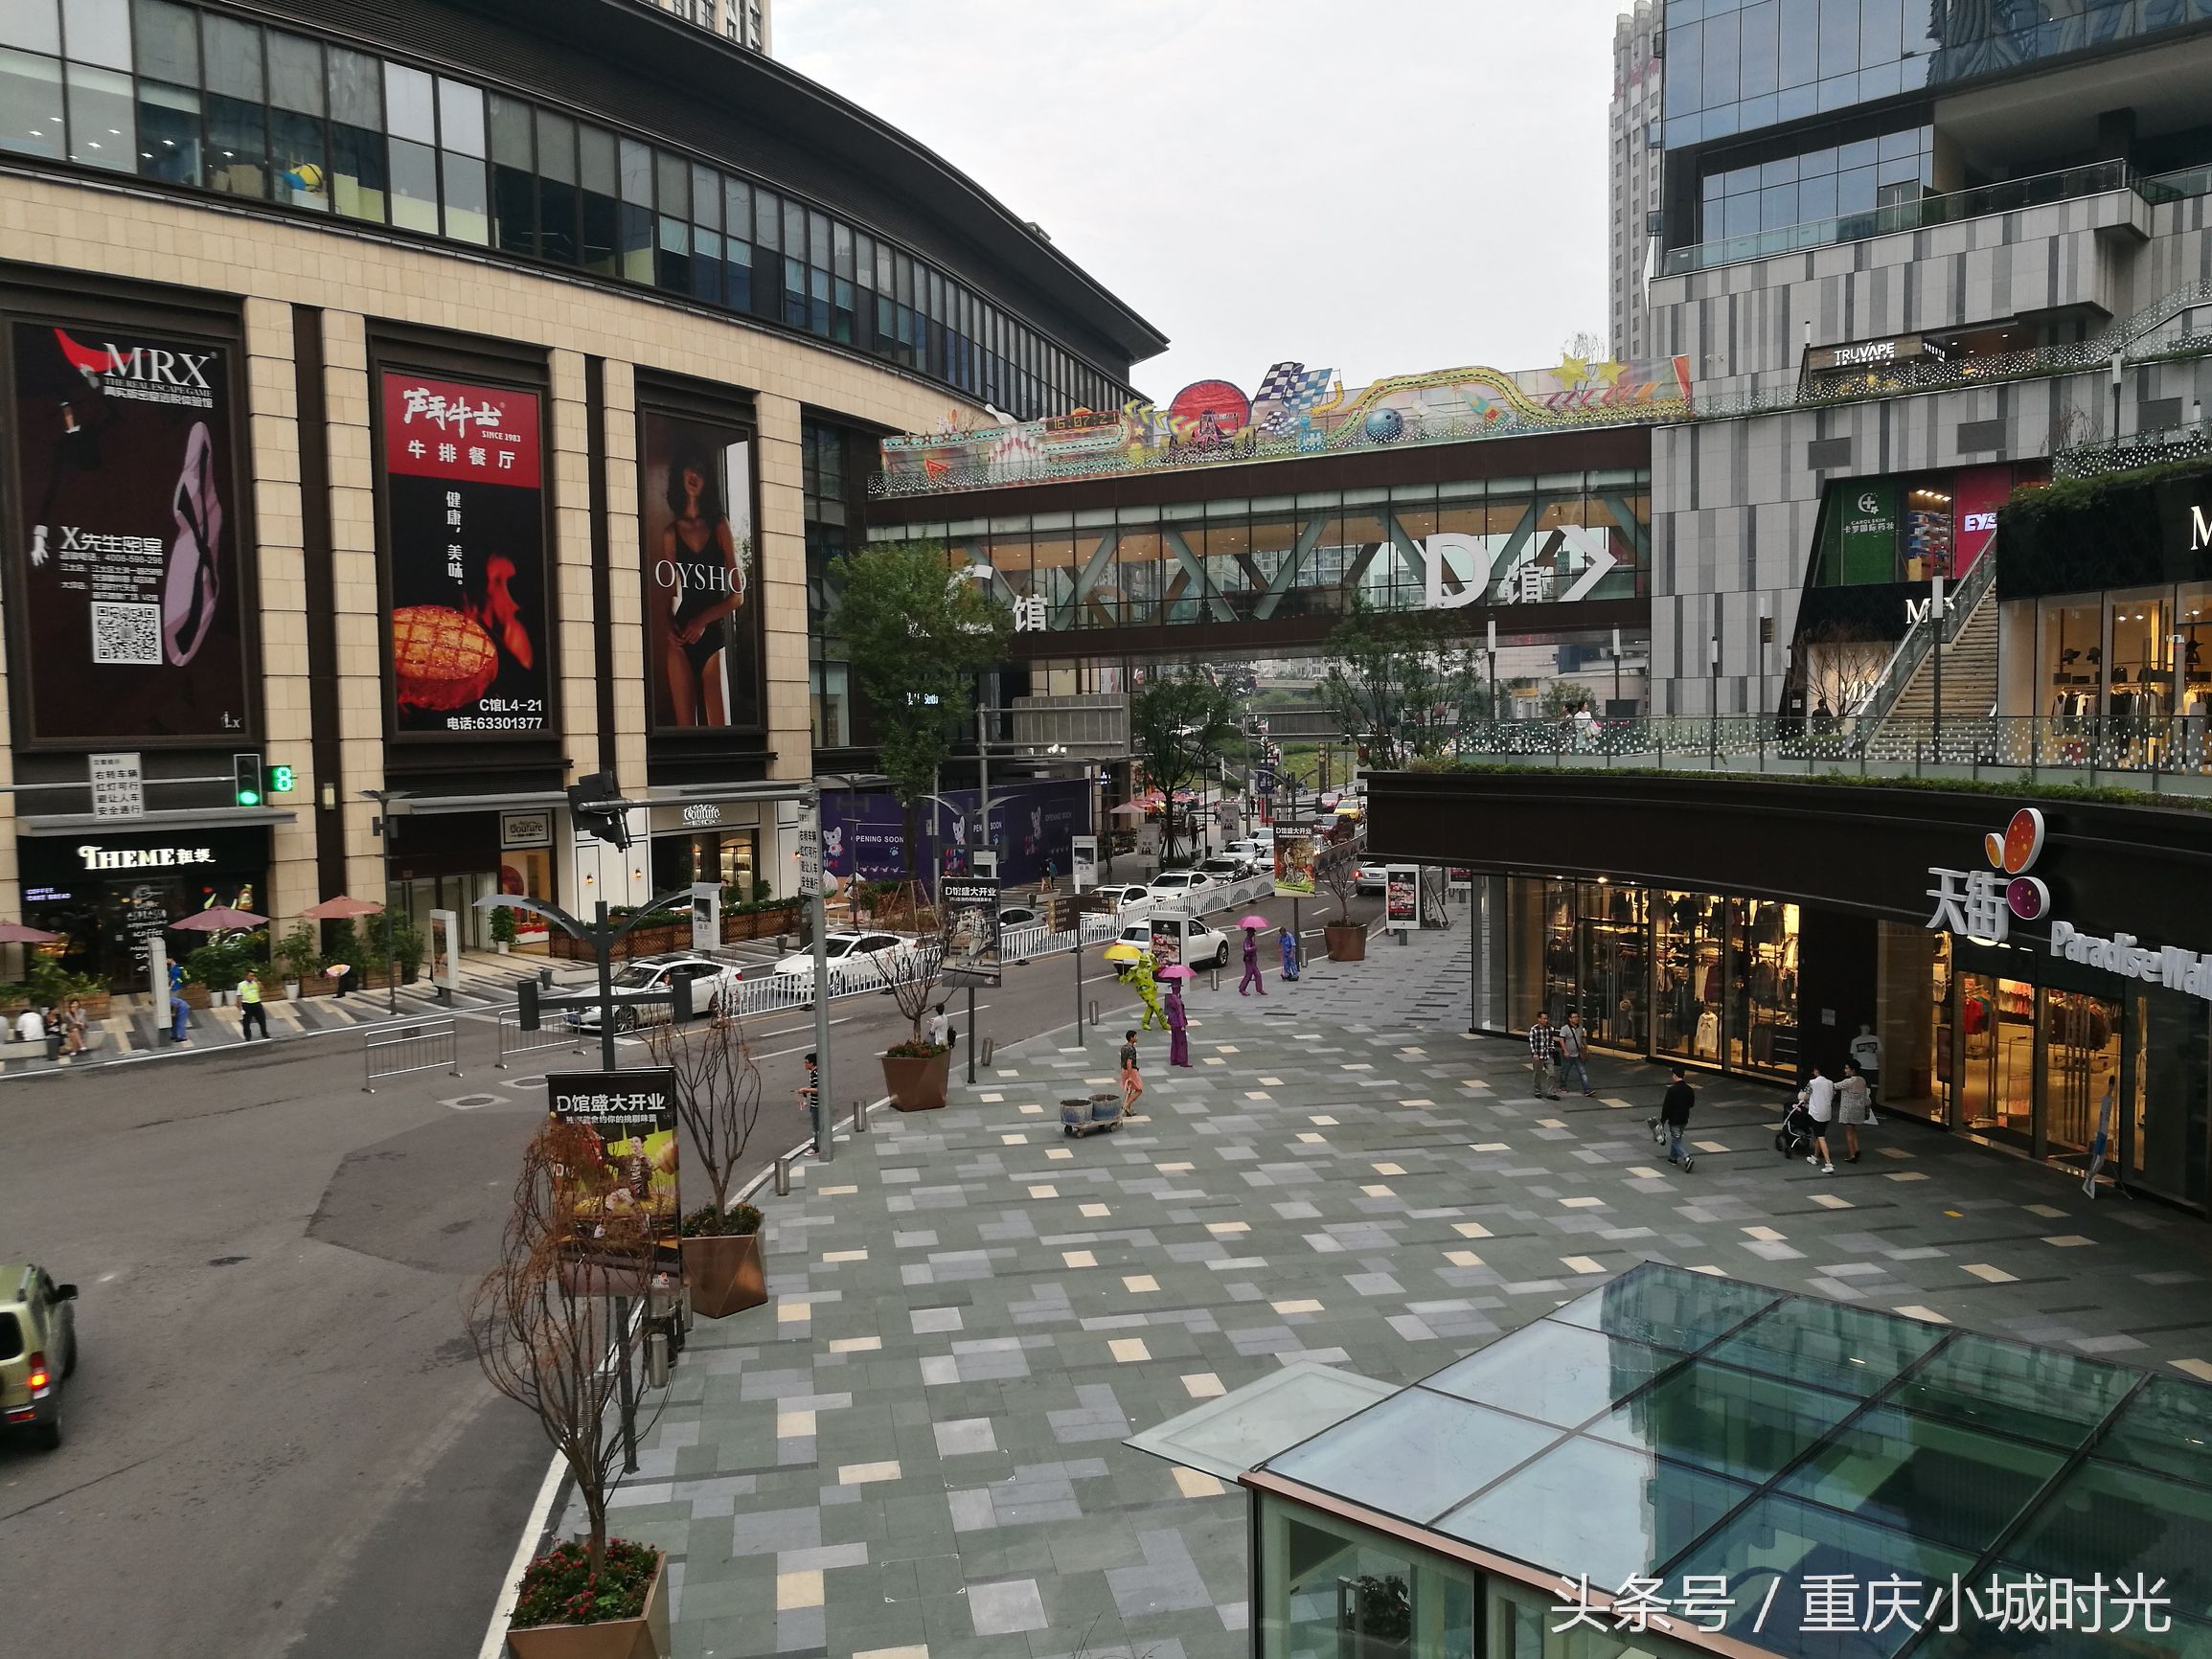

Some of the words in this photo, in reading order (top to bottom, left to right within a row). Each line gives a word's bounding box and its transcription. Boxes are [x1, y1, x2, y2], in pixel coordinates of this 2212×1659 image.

[103, 343, 212, 389] MRX
[126, 379, 148, 390] REAL
[152, 383, 184, 394] ESCAPE
[185, 387, 213, 398] GAME
[482, 430, 503, 440] SINCE
[505, 433, 521, 443] 1983
[408, 440, 515, 469] 牛排餐厅
[655, 559, 746, 594] OYSHO
[95, 769, 138, 780] 右转车辆
[274, 767, 291, 791] 8
[96, 781, 139, 792] 红灯可行
[97, 794, 140, 803] 避让人车
[98, 806, 141, 815] 安全通行
[26, 887, 55, 896] COFFEE
[1927, 868, 2009, 942] 天街
[2050, 920, 2163, 983] Paradise
[557, 1093, 666, 1112] D馆盛大开业
